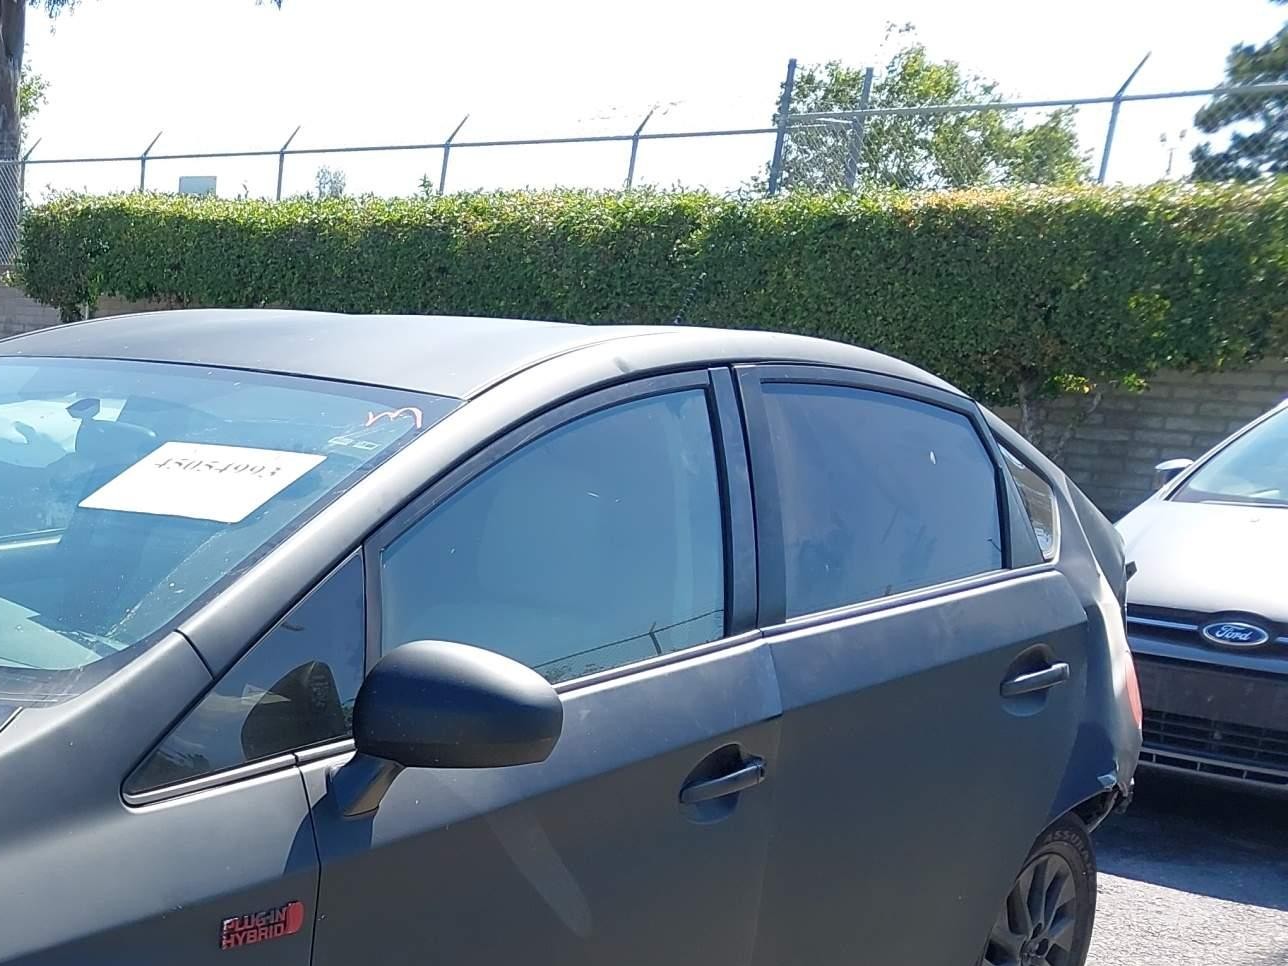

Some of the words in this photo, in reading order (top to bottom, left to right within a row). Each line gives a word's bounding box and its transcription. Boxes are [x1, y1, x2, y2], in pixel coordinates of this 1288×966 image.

[153, 457, 282, 479] 45054993
[1214, 624, 1254, 642] Ford
[223, 907, 288, 934] PLUG-IN
[221, 922, 285, 951] HYBRID
